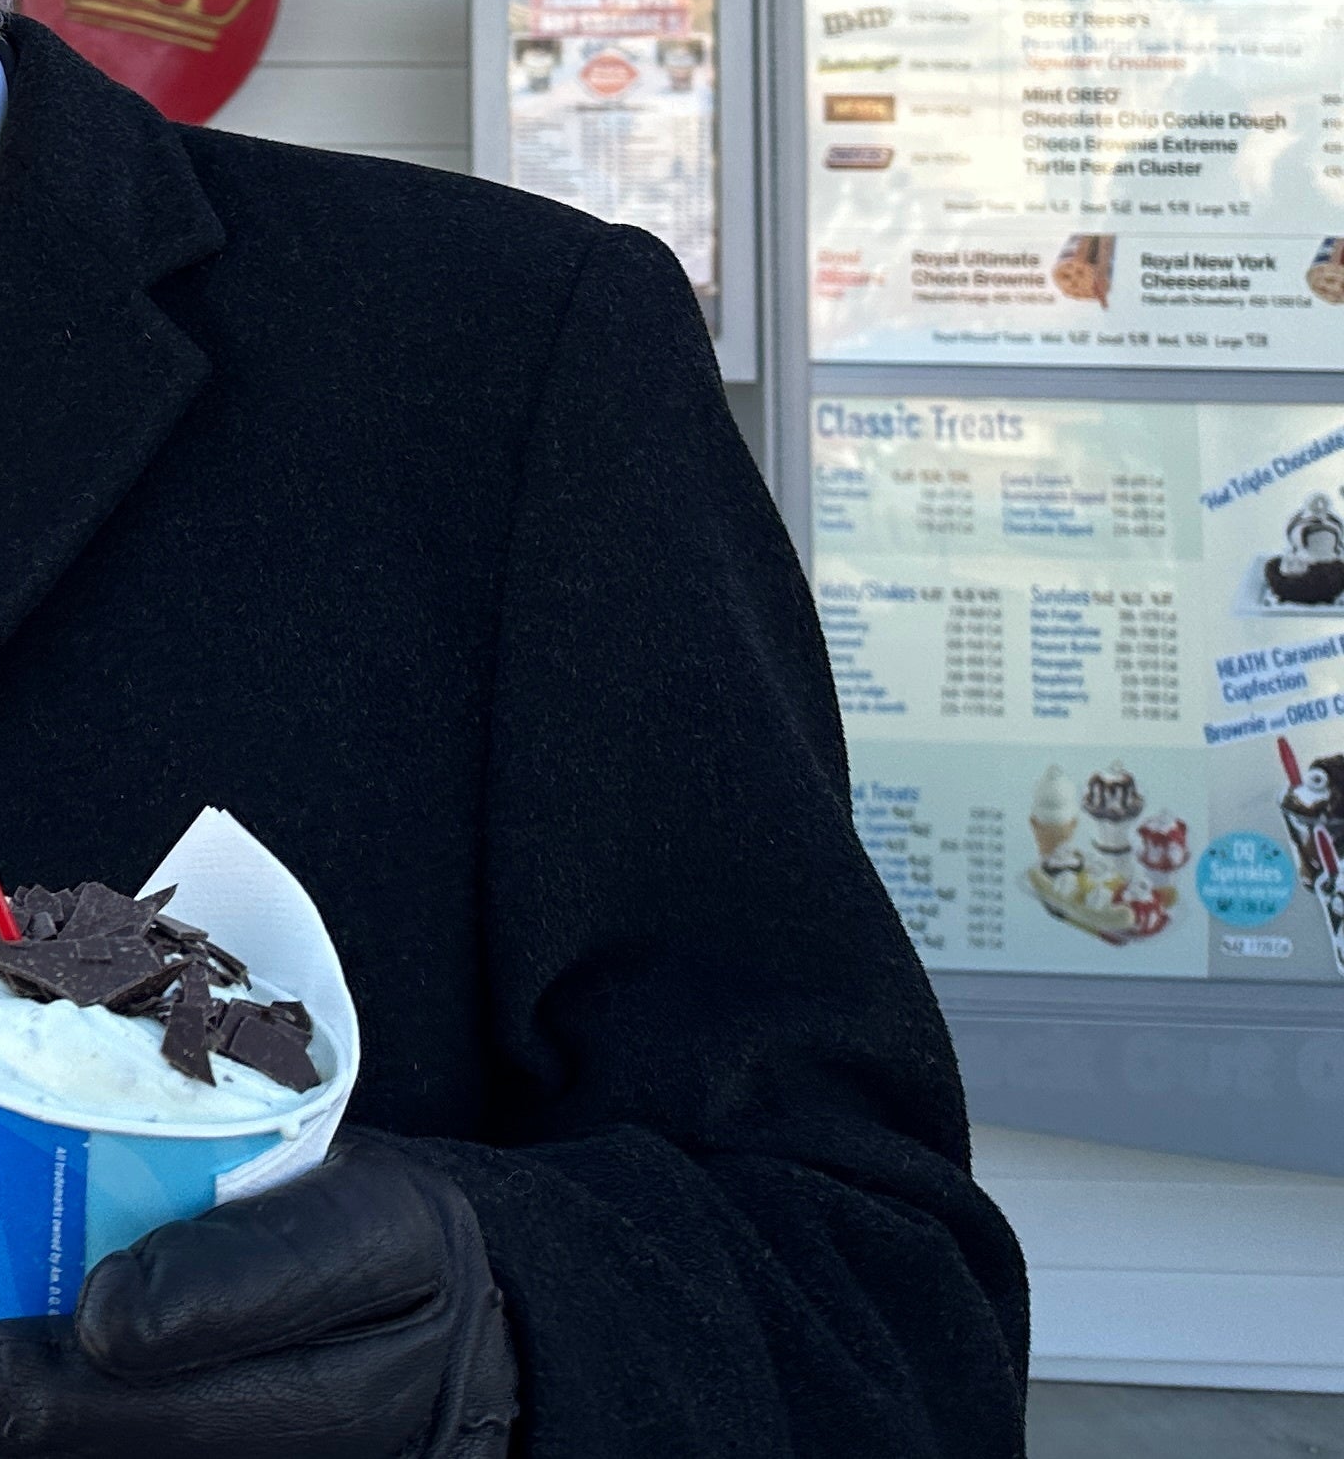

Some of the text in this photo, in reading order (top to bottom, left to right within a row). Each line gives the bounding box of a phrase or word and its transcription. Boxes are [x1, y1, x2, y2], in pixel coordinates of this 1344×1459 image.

[1022, 88, 1062, 104] Mint
[1022, 111, 1287, 133] Chocolate Chip Cookie Dough
[1084, 135, 1159, 153] Brownie
[1162, 135, 1239, 155] Extreme
[1025, 158, 1203, 177] Turtle Pecan Cluster
[963, 250, 1040, 266] Ultimate
[1141, 252, 1276, 273] Royal New York
[973, 271, 1046, 287] Brownie
[1141, 274, 1251, 291] Cheesecake
[816, 402, 1024, 441] Classic Treats
[1228, 469, 1274, 498] Triple
[1272, 638, 1338, 668] Caramel
[1223, 672, 1308, 703] Cupfection
[1204, 713, 1267, 744] Brownie
[1286, 698, 1329, 726] OREO
[52, 1162, 66, 1217] trademarks
[50, 1218, 64, 1251] owned
